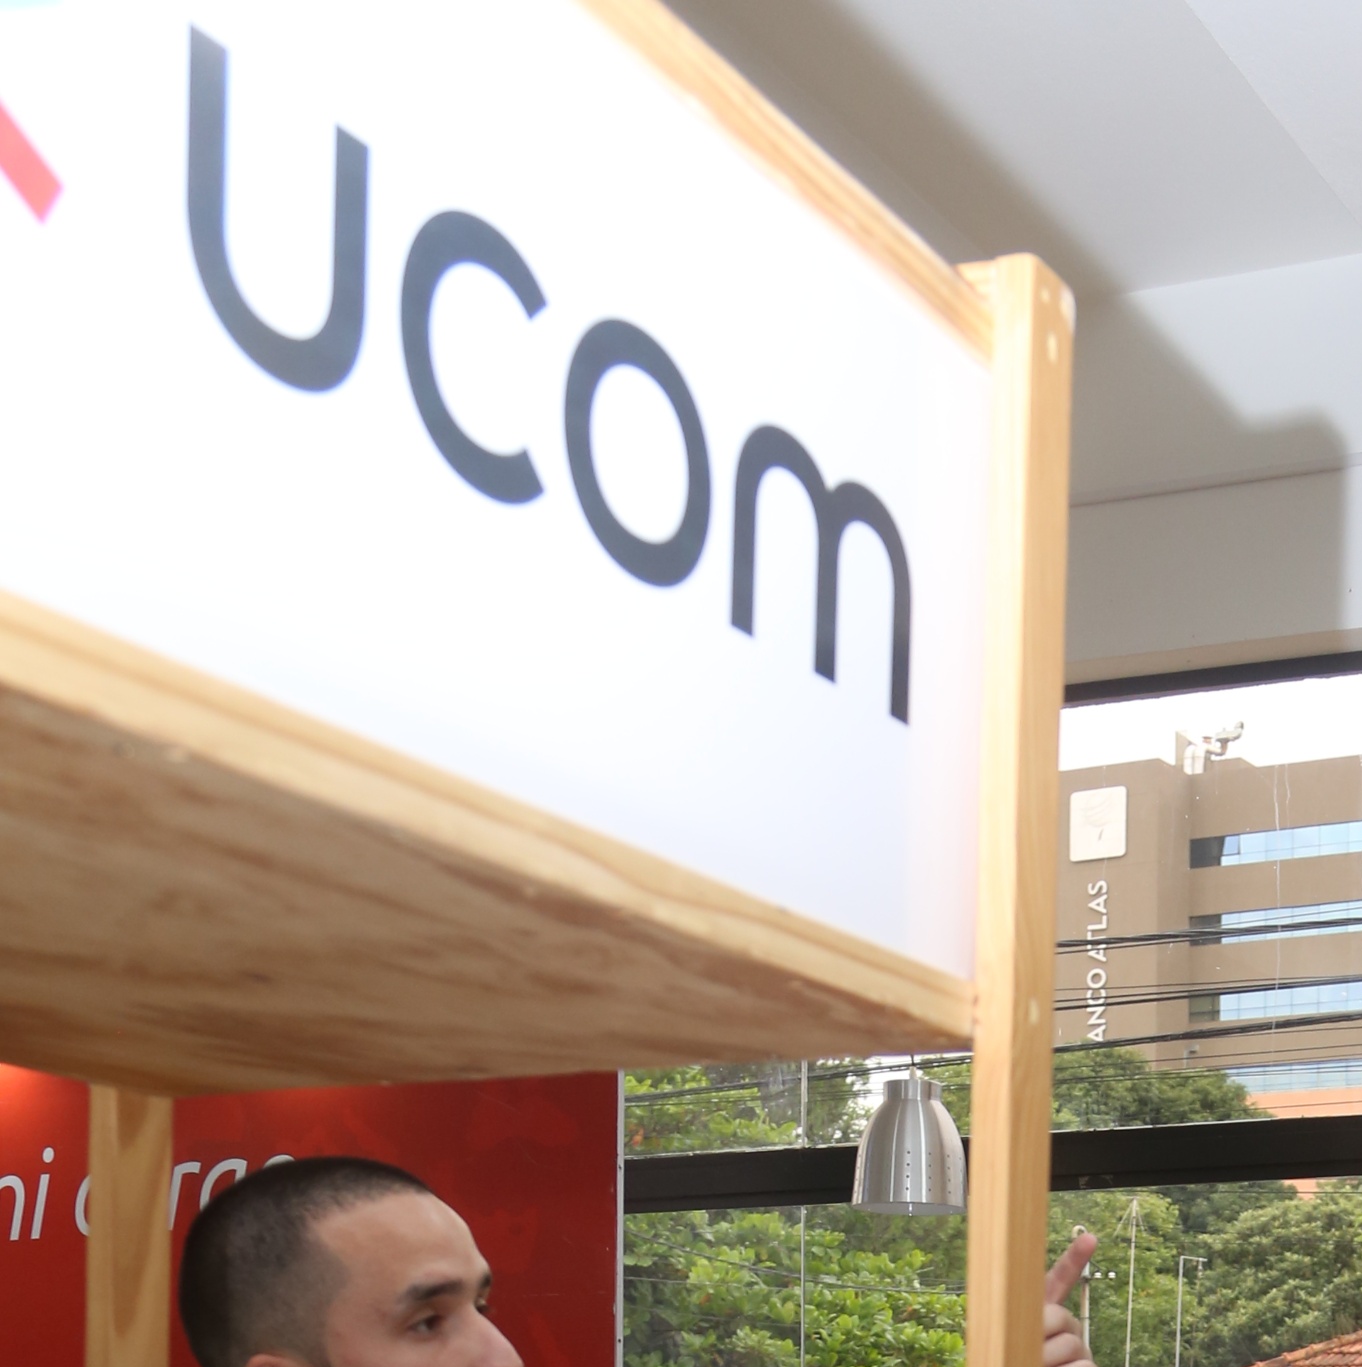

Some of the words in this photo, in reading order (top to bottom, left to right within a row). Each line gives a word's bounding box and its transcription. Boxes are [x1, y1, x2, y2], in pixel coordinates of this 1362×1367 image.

[186, 23, 912, 726] ucom
[1087, 880, 1108, 962] ATLAS
[1086, 967, 1107, 1042] ANCO
